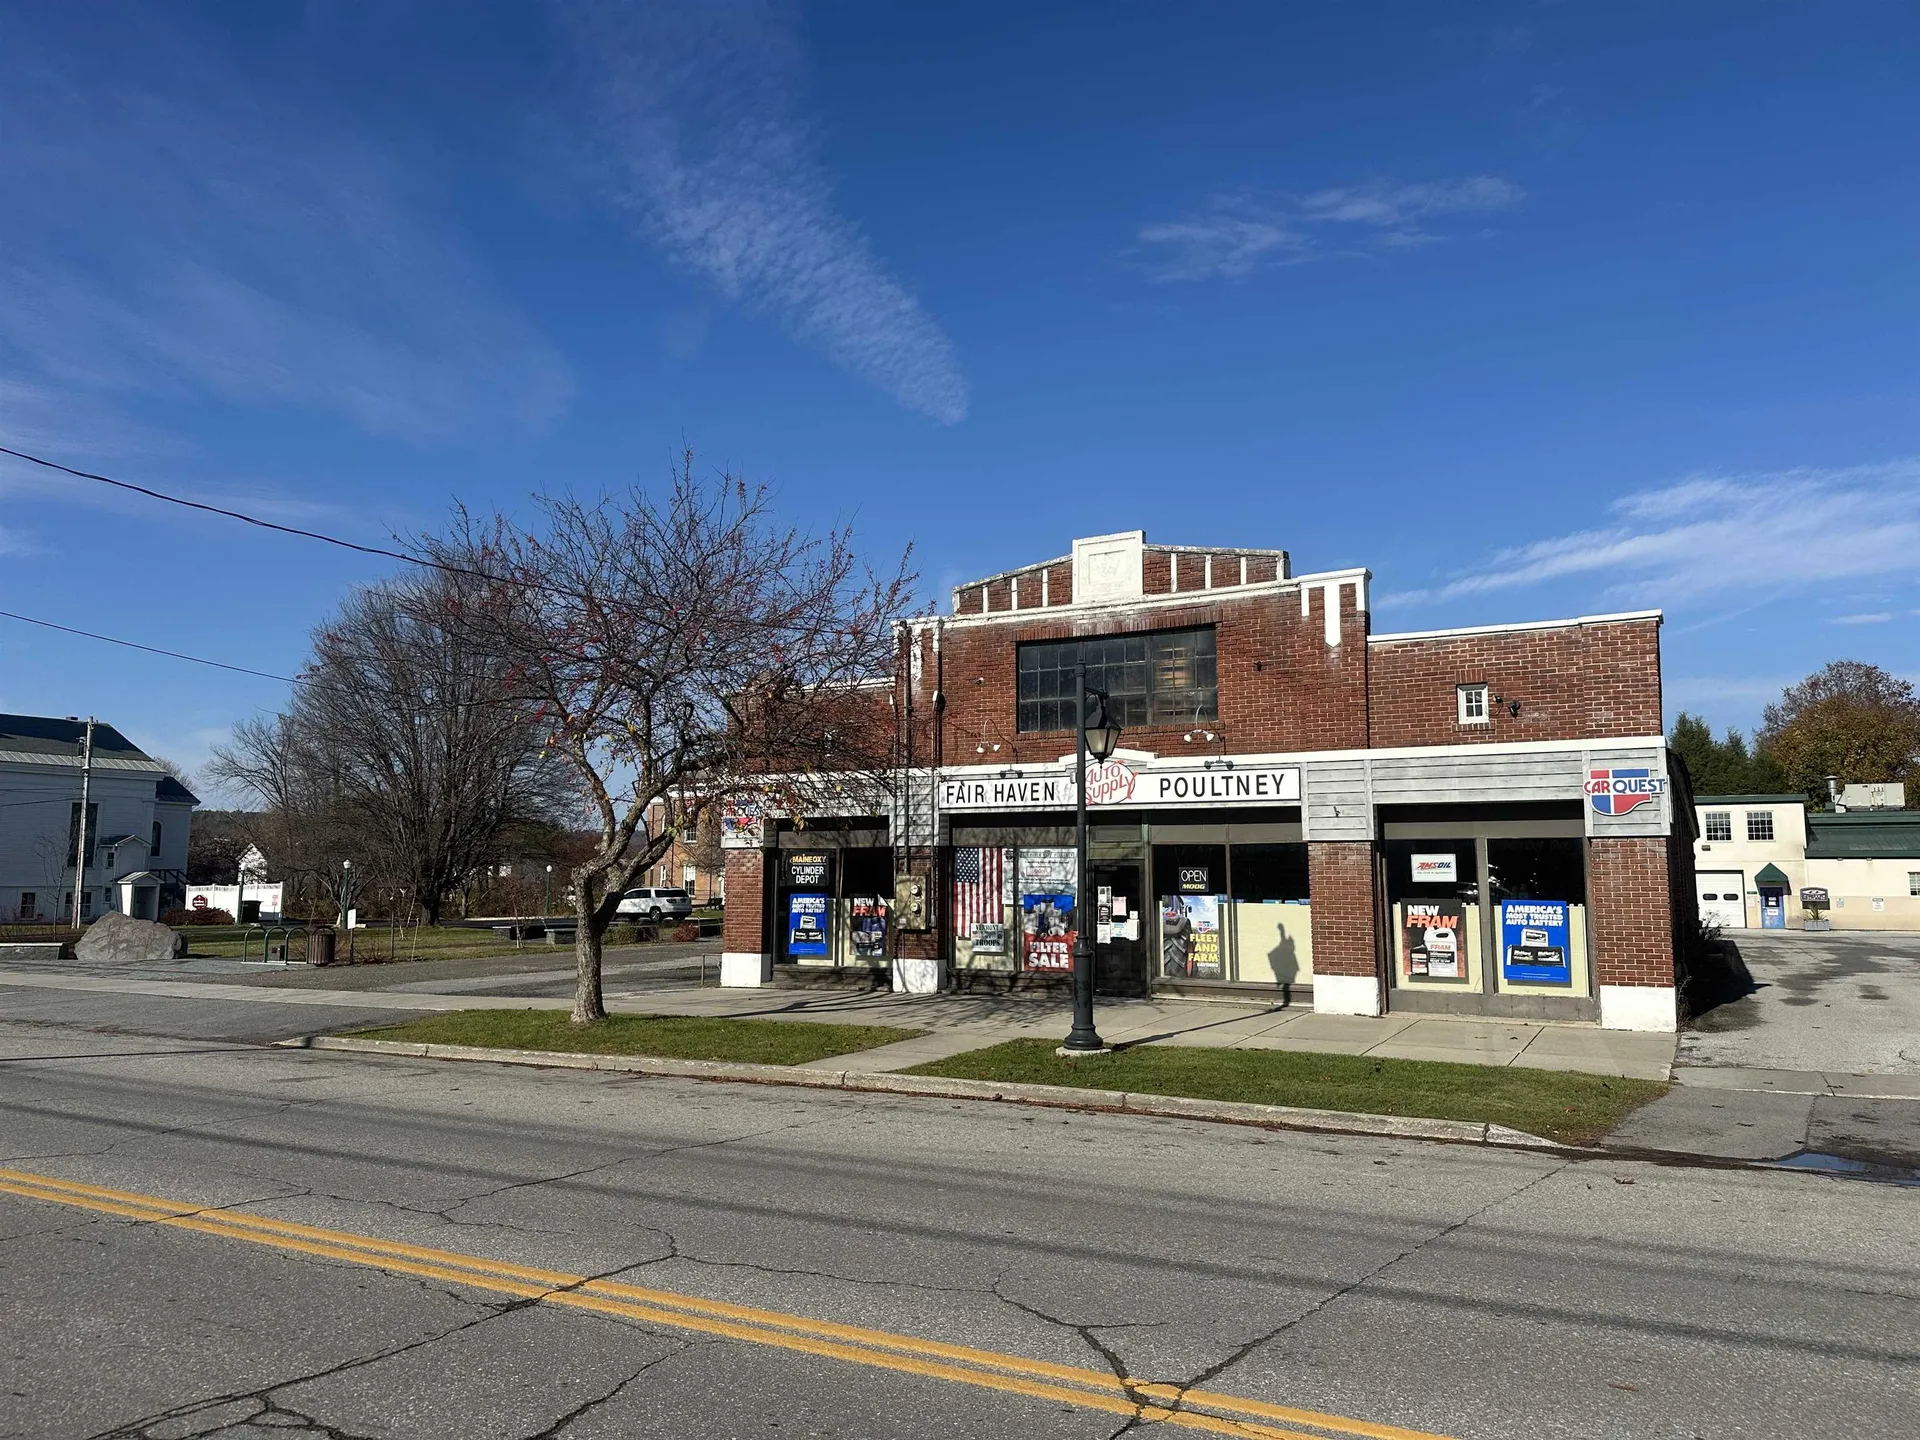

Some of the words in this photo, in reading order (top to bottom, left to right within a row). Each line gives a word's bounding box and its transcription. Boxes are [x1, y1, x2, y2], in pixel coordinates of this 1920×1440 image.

[1086, 764, 1121, 785] AUTO
[946, 784, 985, 803] FAIR
[994, 782, 1055, 802] HAVEN
[1160, 774, 1285, 798] POULTNEY
[791, 866, 824, 875] CYLINDER
[795, 875, 819, 884] DEPOT
[1181, 870, 1207, 882] OPEN
[853, 897, 875, 907] NEW
[852, 906, 887, 917] FRAM
[1407, 904, 1440, 916] NEW
[1506, 904, 1563, 914] AMERICA'S
[1406, 915, 1459, 929] FRAM
[1529, 919, 1563, 927] BATTERY
[1190, 933, 1218, 942] FLEET
[1029, 941, 1068, 953] FILTER
[1194, 943, 1218, 952] AND
[1028, 953, 1069, 968] SALE
[1188, 953, 1218, 962] FARM
